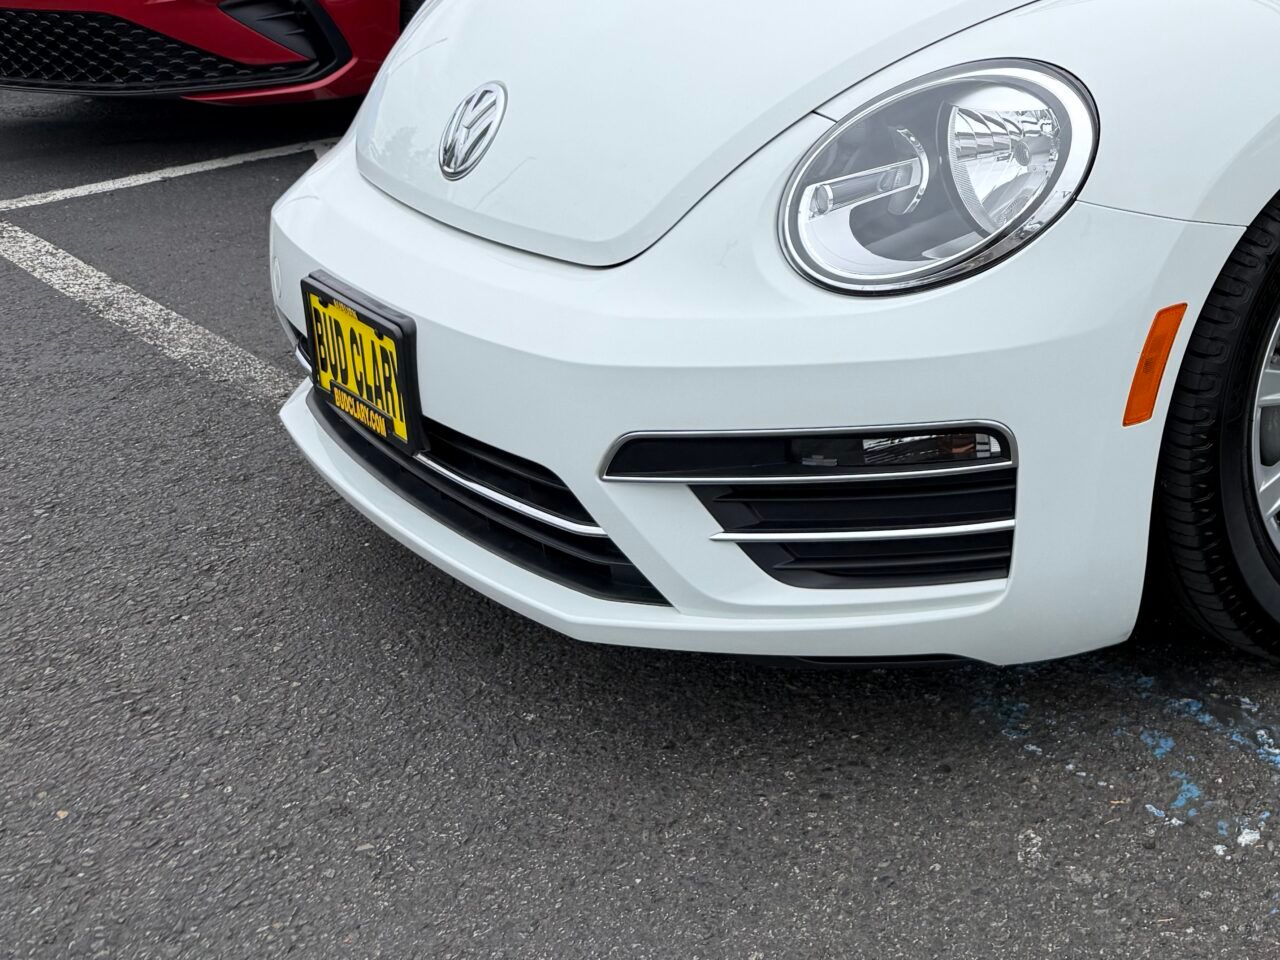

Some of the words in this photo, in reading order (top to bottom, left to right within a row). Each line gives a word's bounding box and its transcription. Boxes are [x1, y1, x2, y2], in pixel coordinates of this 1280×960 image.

[313, 306, 349, 386] BUD
[350, 326, 405, 424] CLARY
[333, 387, 387, 438] BUDCLARY.COM
